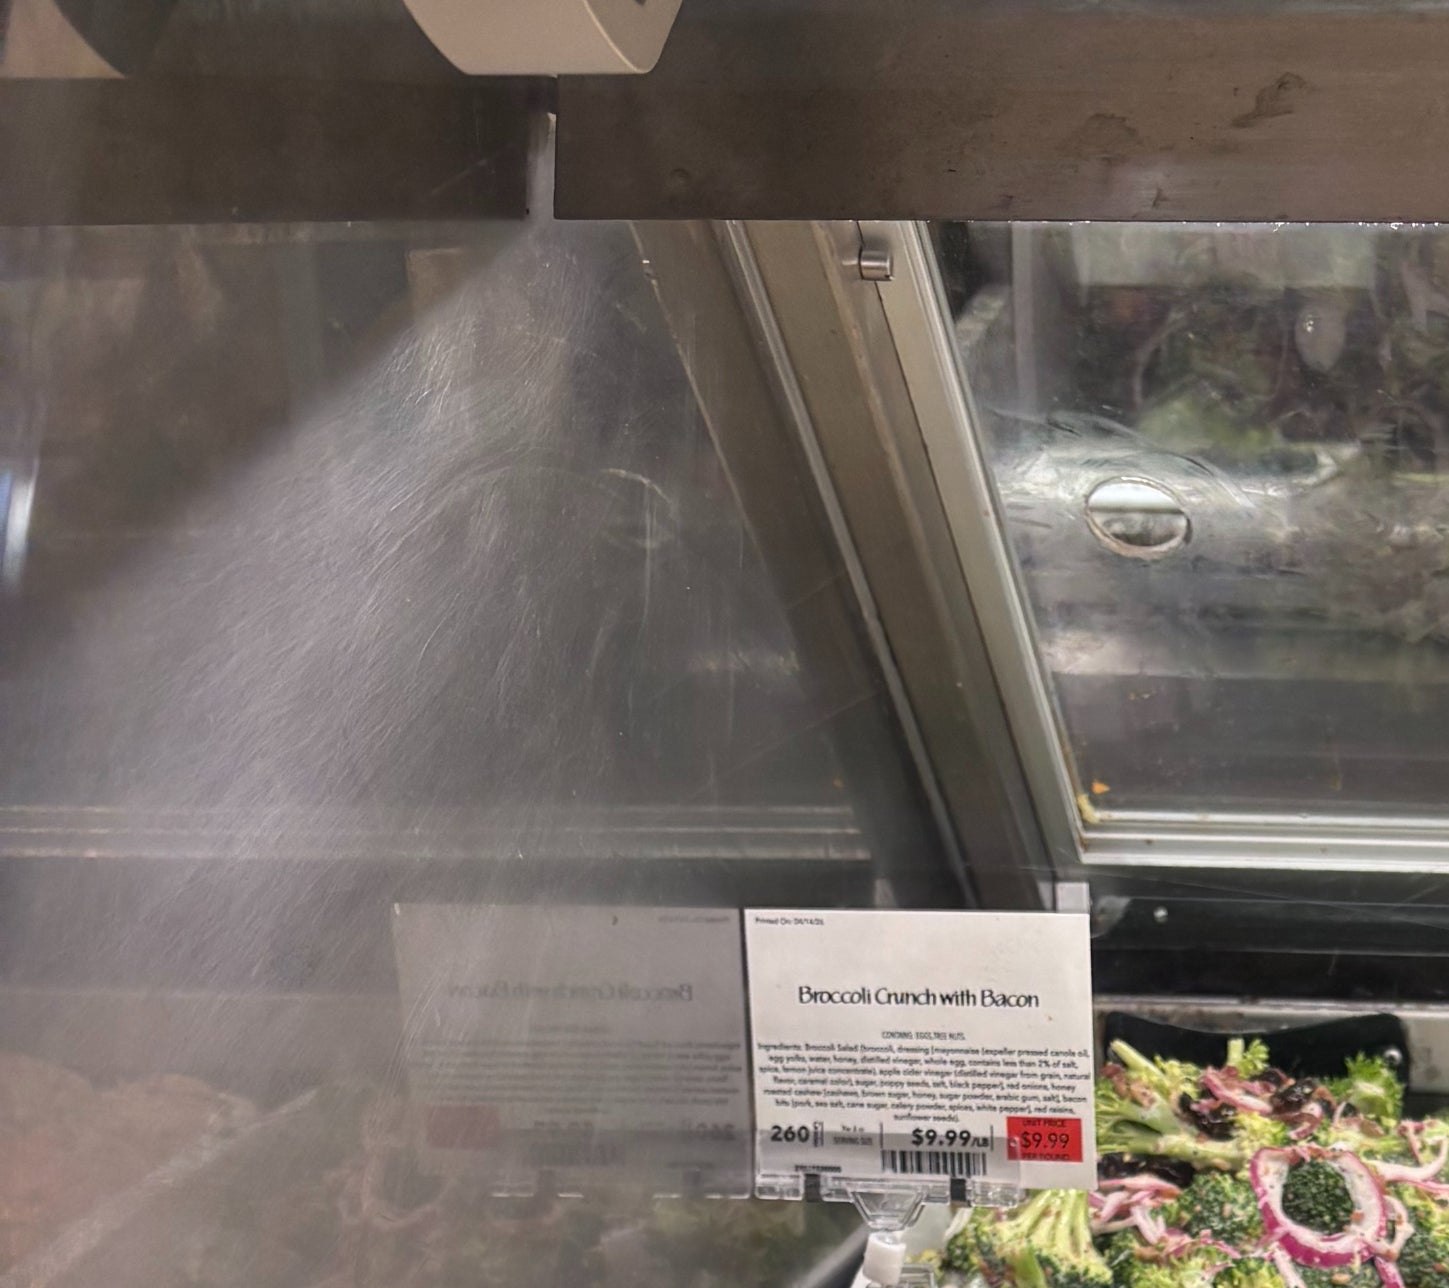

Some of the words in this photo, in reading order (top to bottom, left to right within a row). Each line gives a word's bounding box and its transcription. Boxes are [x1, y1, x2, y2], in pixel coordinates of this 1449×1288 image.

[798, 985, 871, 1004] Broccoli
[874, 987, 936, 1005] Crunch
[939, 989, 976, 1006] with
[980, 989, 1039, 1007] Bacon
[770, 1125, 810, 1142] 260
[1021, 1131, 1070, 1150] $9.99
